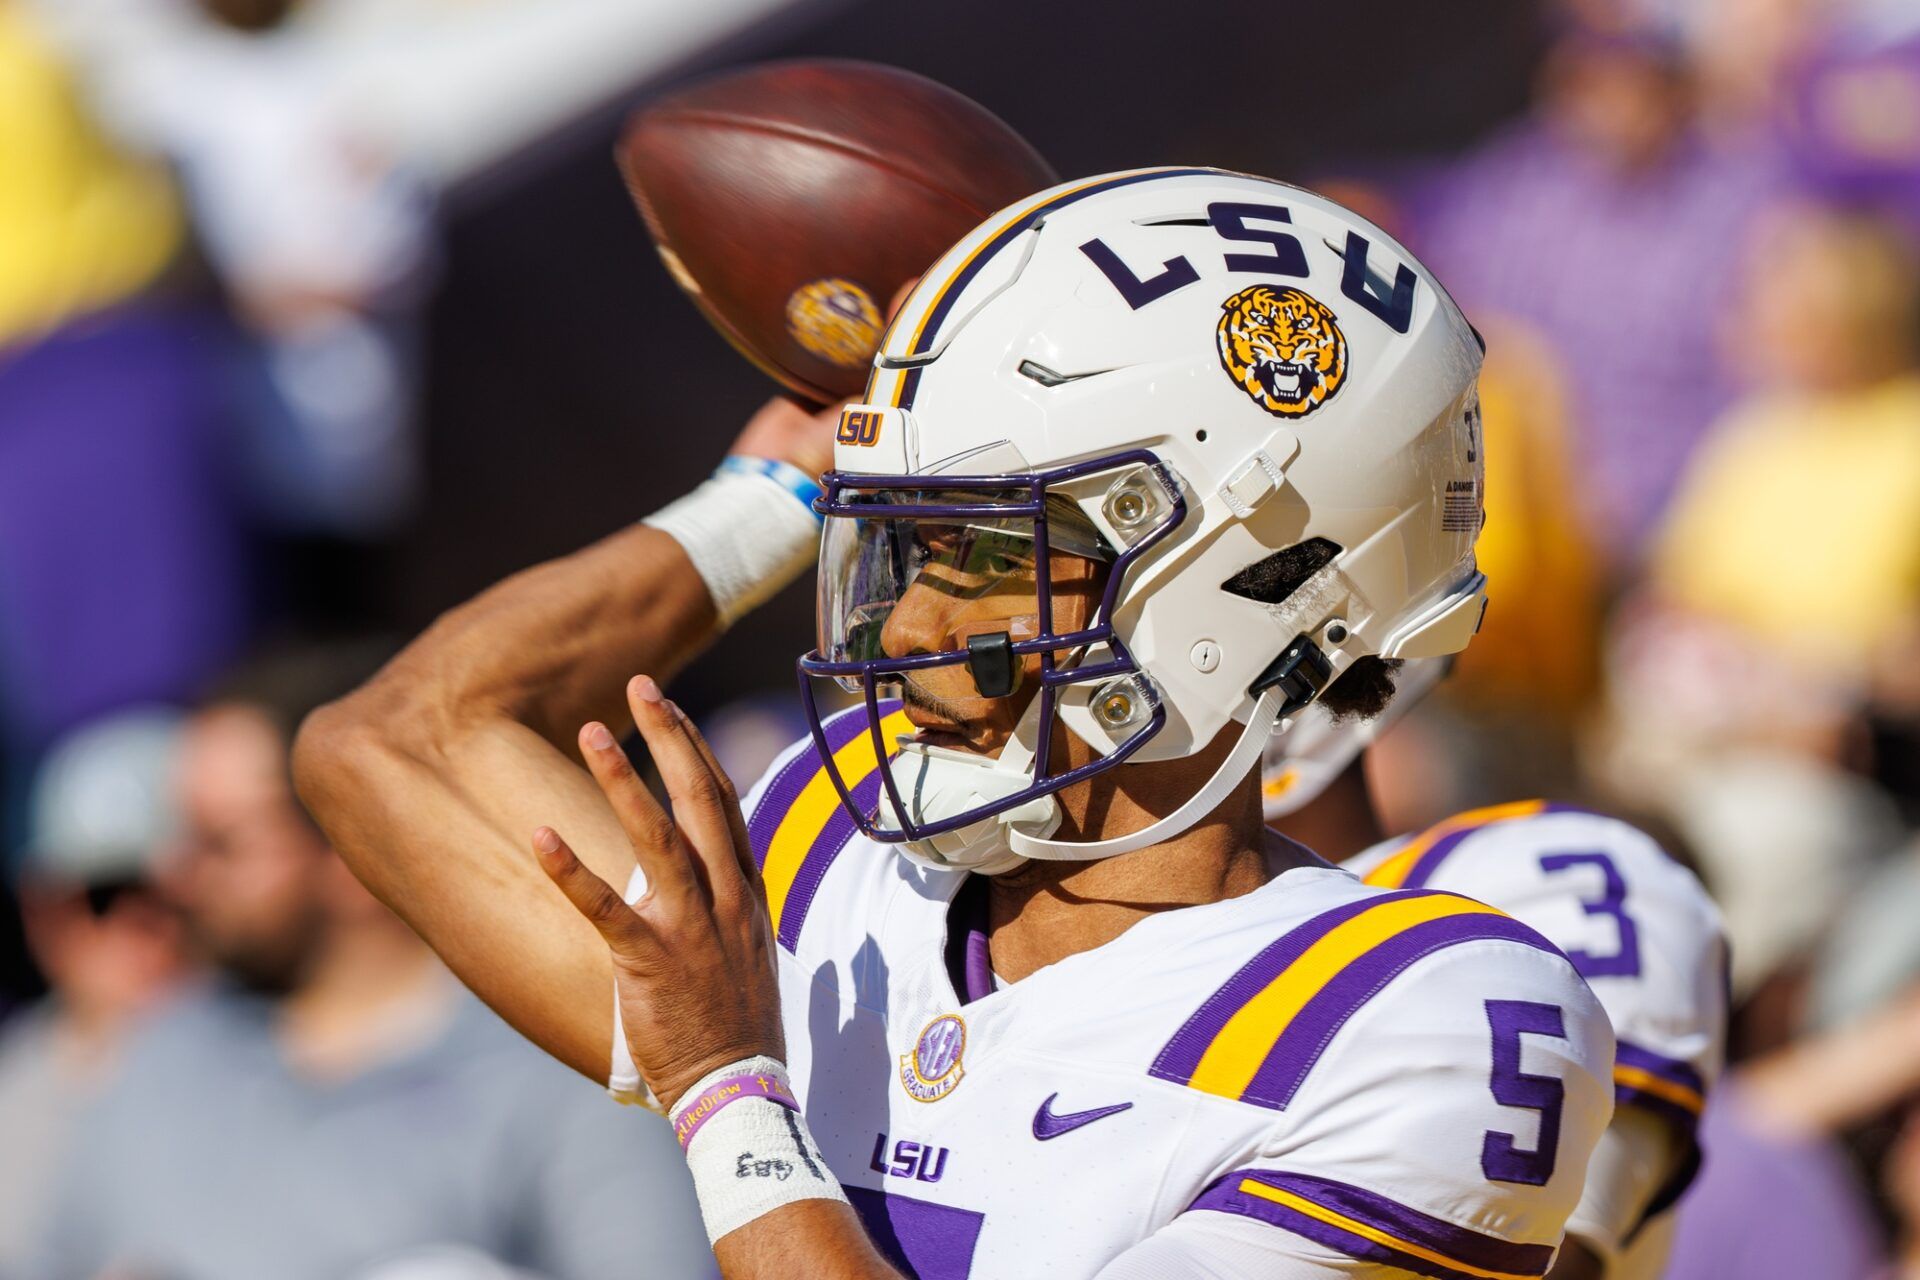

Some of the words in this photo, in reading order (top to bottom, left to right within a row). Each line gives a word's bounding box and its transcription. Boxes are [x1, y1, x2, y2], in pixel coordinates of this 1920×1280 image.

[1078, 202, 1418, 334] LSU
[836, 411, 884, 447] LSU
[1539, 853, 1640, 977] 3
[903, 1068, 950, 1099] GRADUATE
[1481, 1000, 1567, 1186] 5
[870, 1133, 949, 1183] LSU
